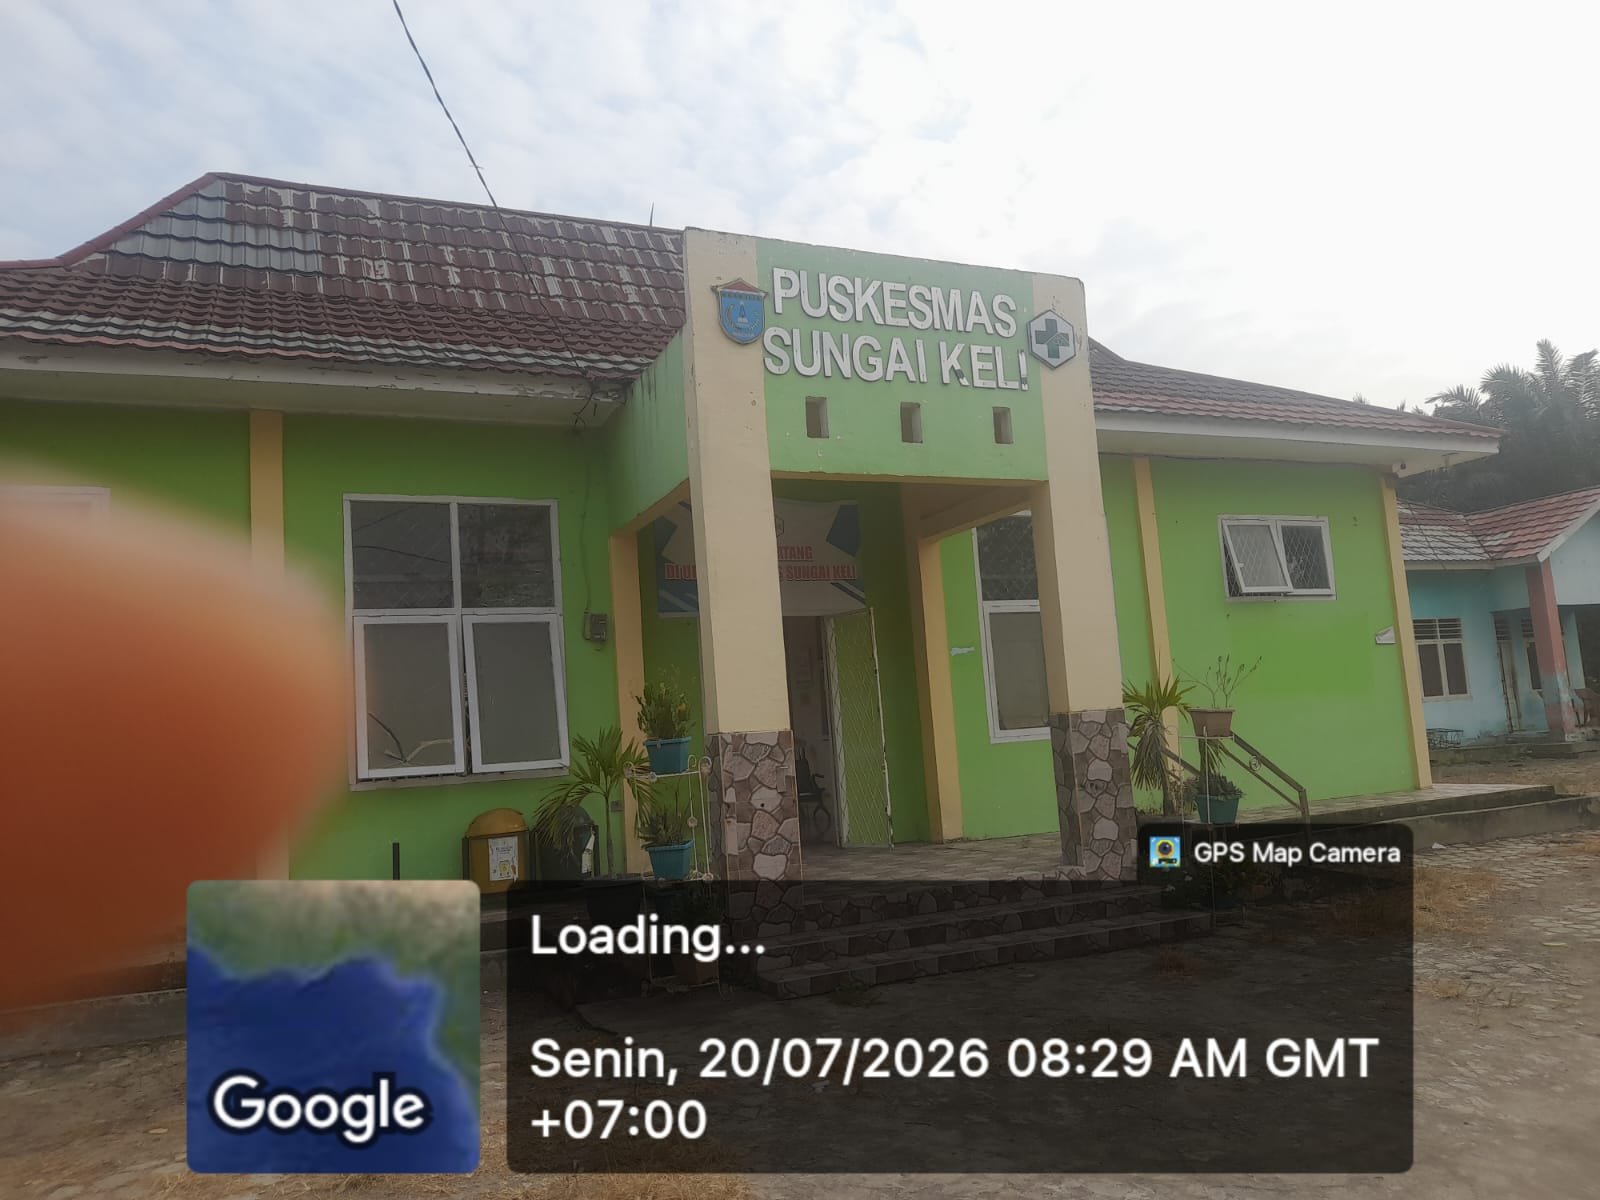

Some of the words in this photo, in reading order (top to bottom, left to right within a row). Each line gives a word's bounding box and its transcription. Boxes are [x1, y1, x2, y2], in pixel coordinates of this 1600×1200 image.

[772, 267, 1017, 338] PUSKESMAS
[763, 327, 928, 384] SUNGAI
[786, 565, 832, 581] SUNGAI
[834, 564, 857, 580] KELI
